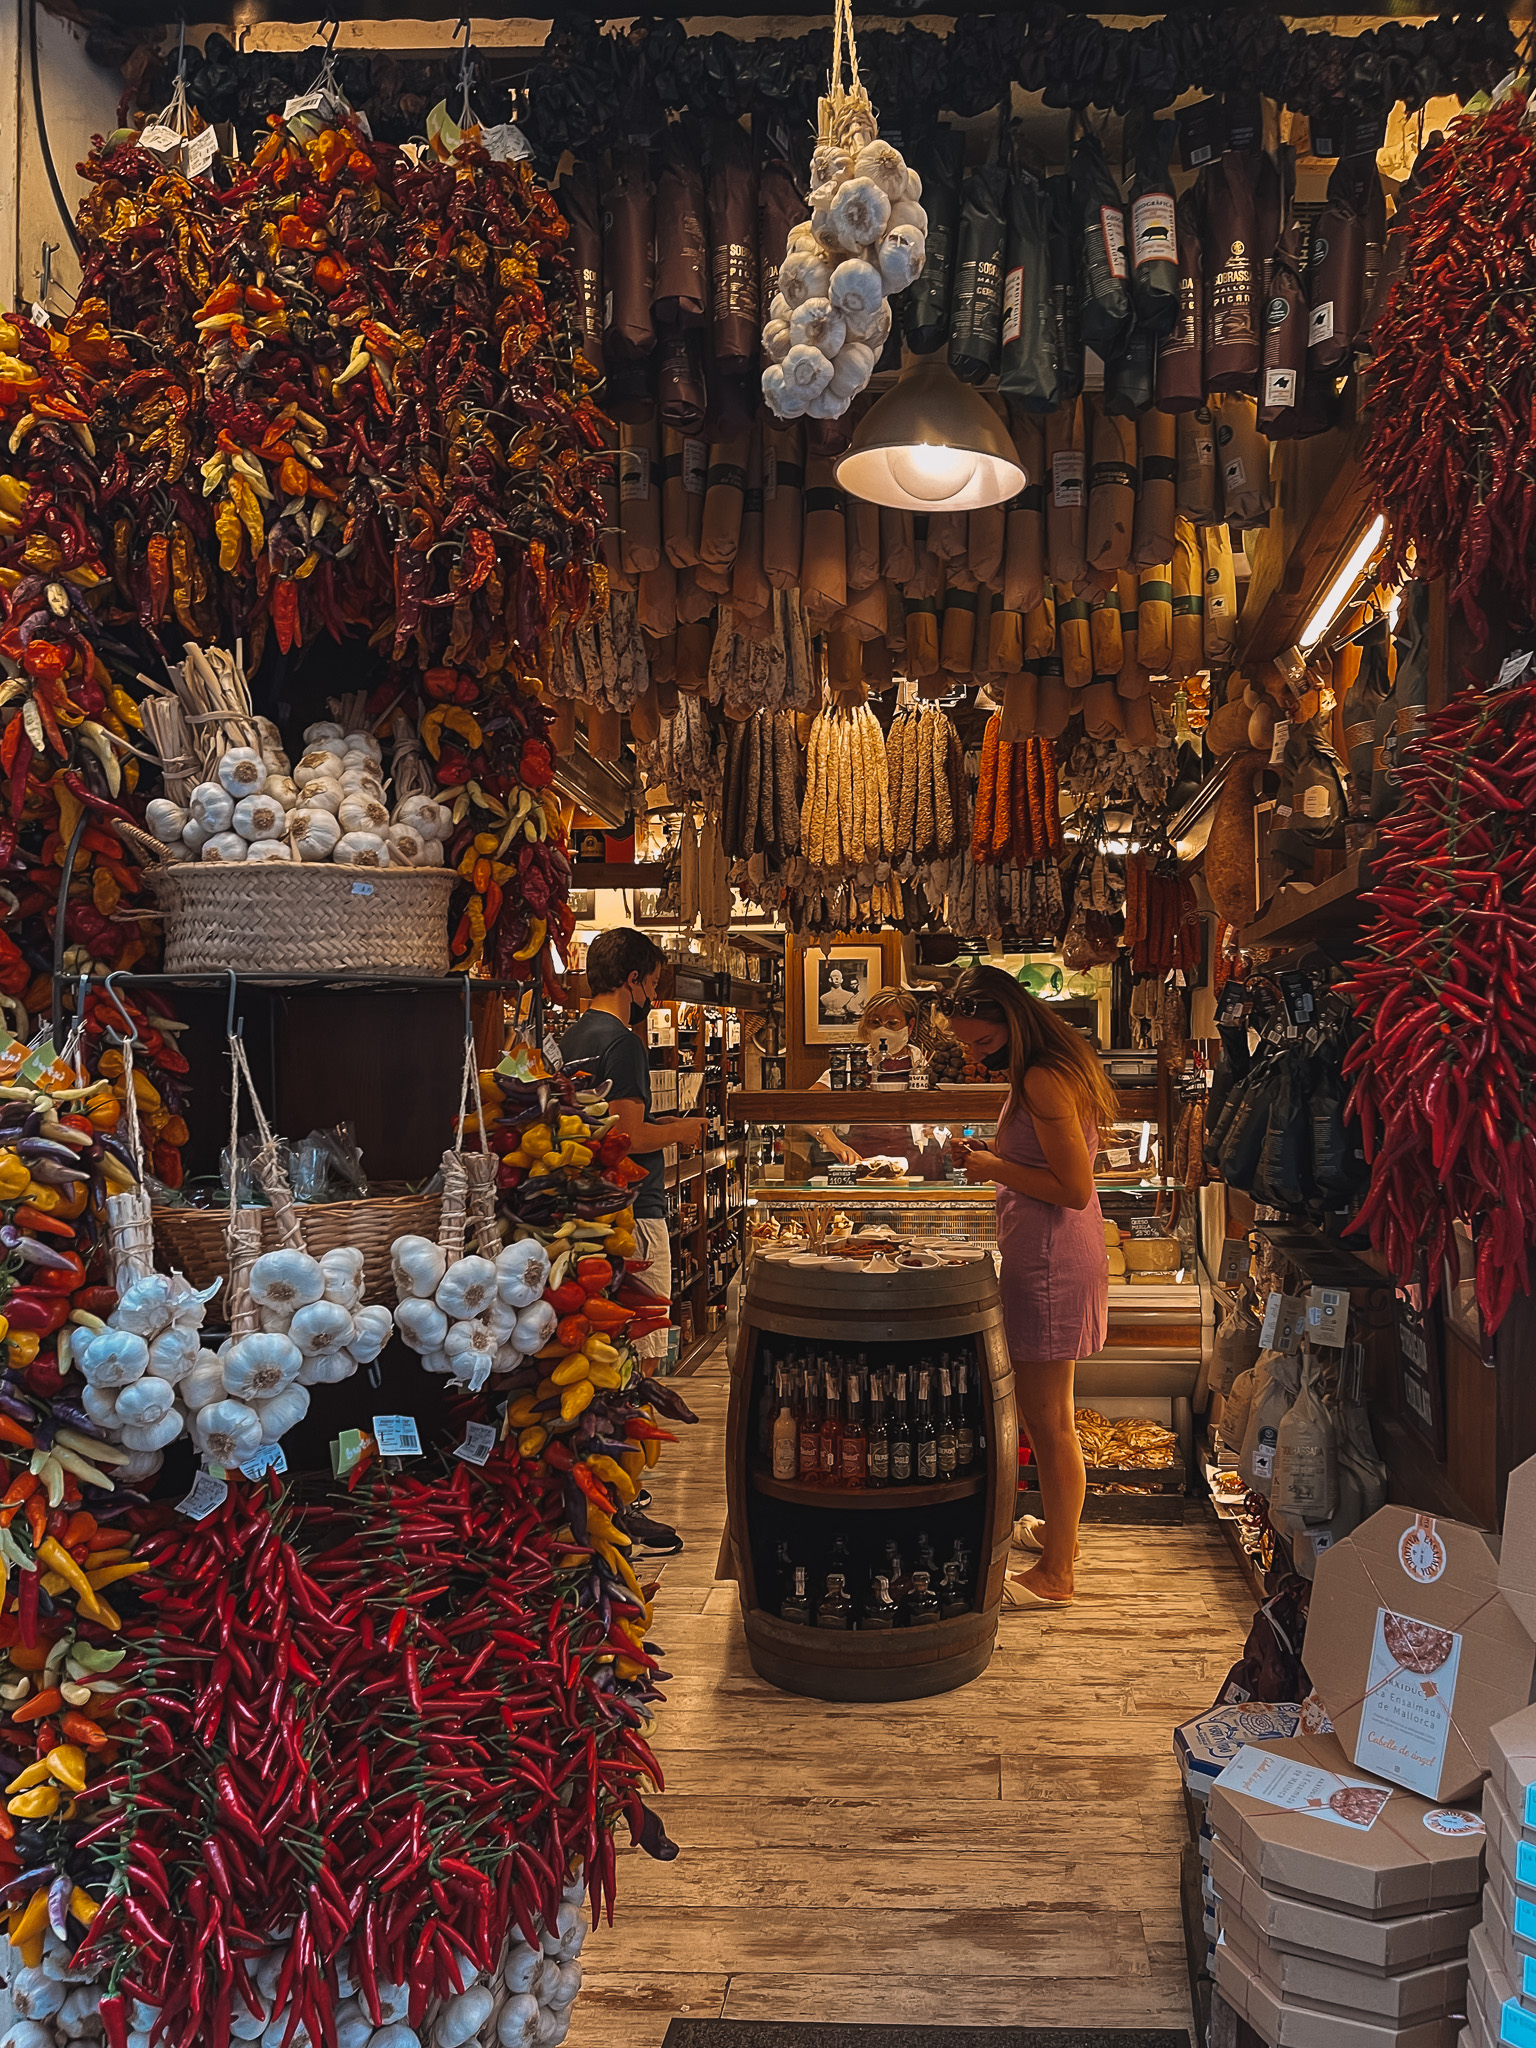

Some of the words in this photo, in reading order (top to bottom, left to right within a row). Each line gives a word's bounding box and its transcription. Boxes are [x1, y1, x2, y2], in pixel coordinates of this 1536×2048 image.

[1377, 1701, 1389, 1712] de
[1393, 1706, 1436, 1730] Mallorca
[1390, 1692, 1441, 1720] Ensaimada
[1367, 1731, 1398, 1752] Cabello
[1398, 1744, 1410, 1758] de
[1410, 1750, 1437, 1767] ángel
